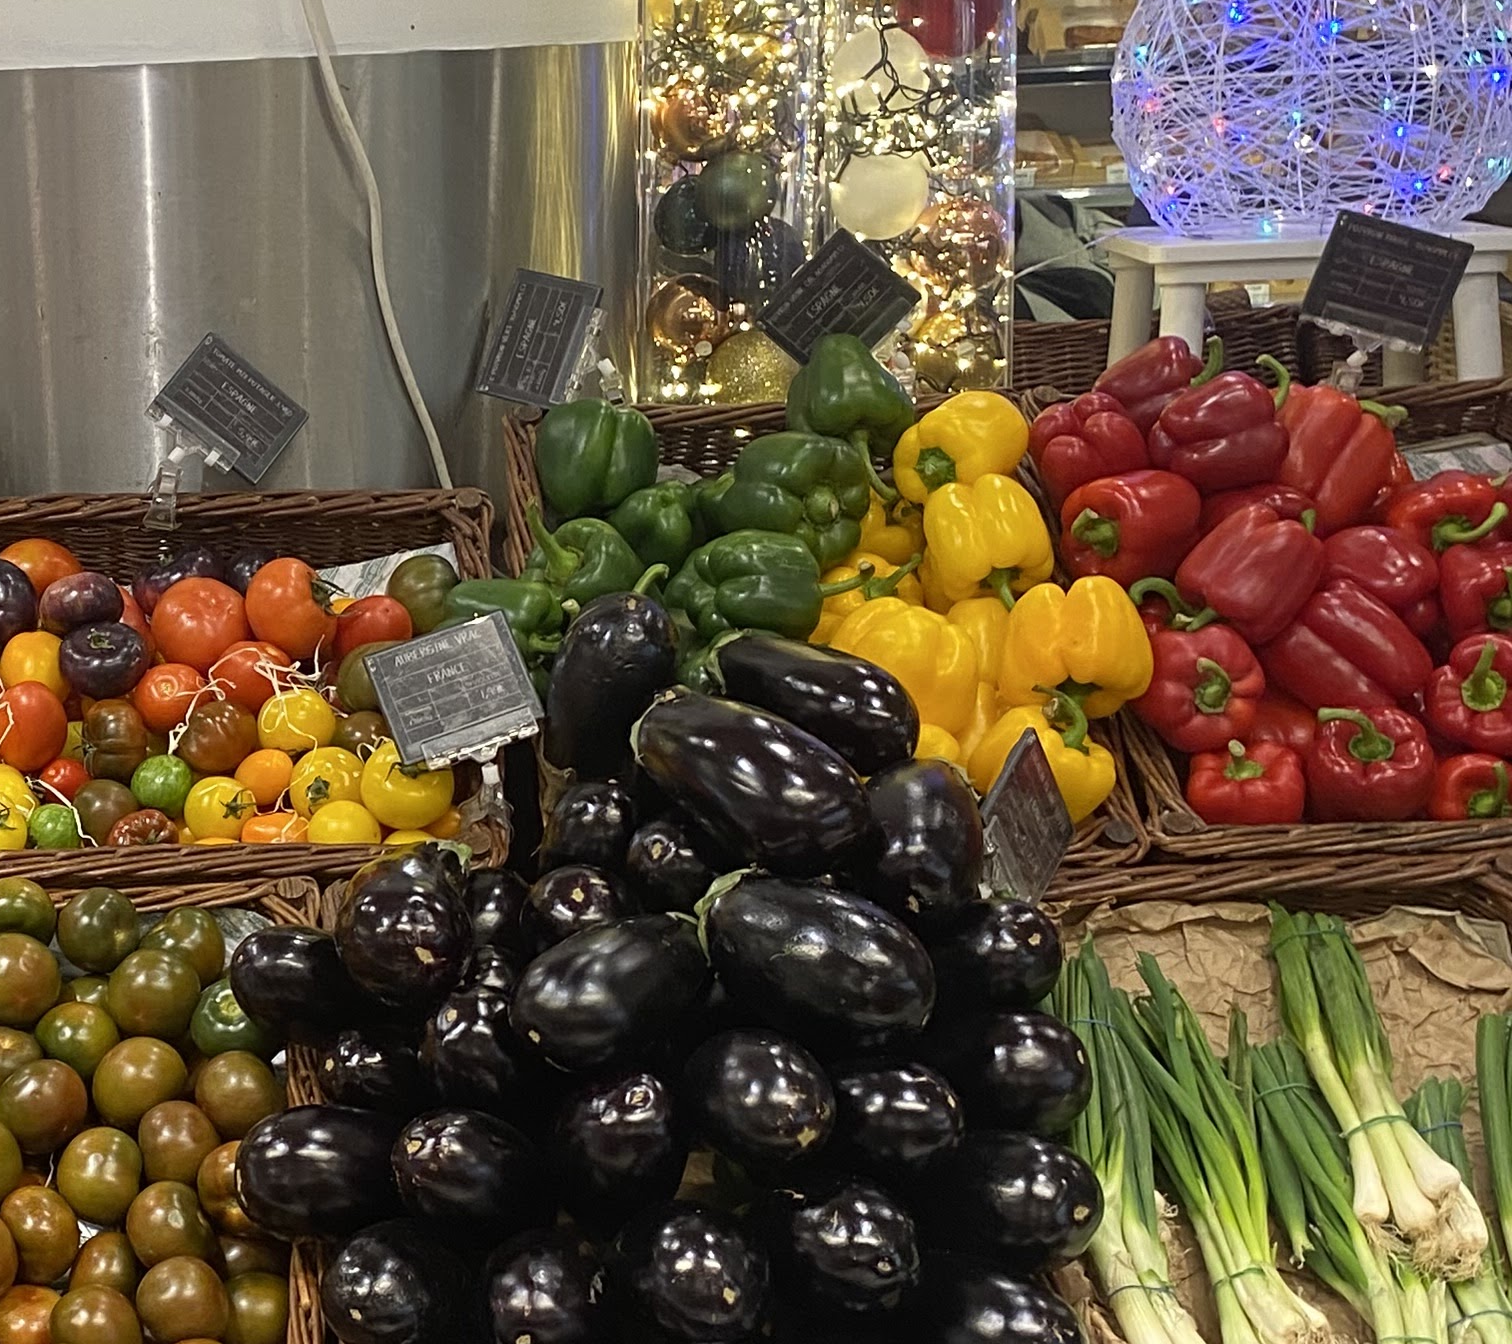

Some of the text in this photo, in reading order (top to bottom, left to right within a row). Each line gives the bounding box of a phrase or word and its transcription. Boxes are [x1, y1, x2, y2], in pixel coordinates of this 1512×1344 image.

[515, 318, 538, 359] ESPAGNE
[221, 381, 257, 415] ESPAGNE
[453, 629, 482, 646] VRAC
[426, 662, 466, 684] FRANCE
